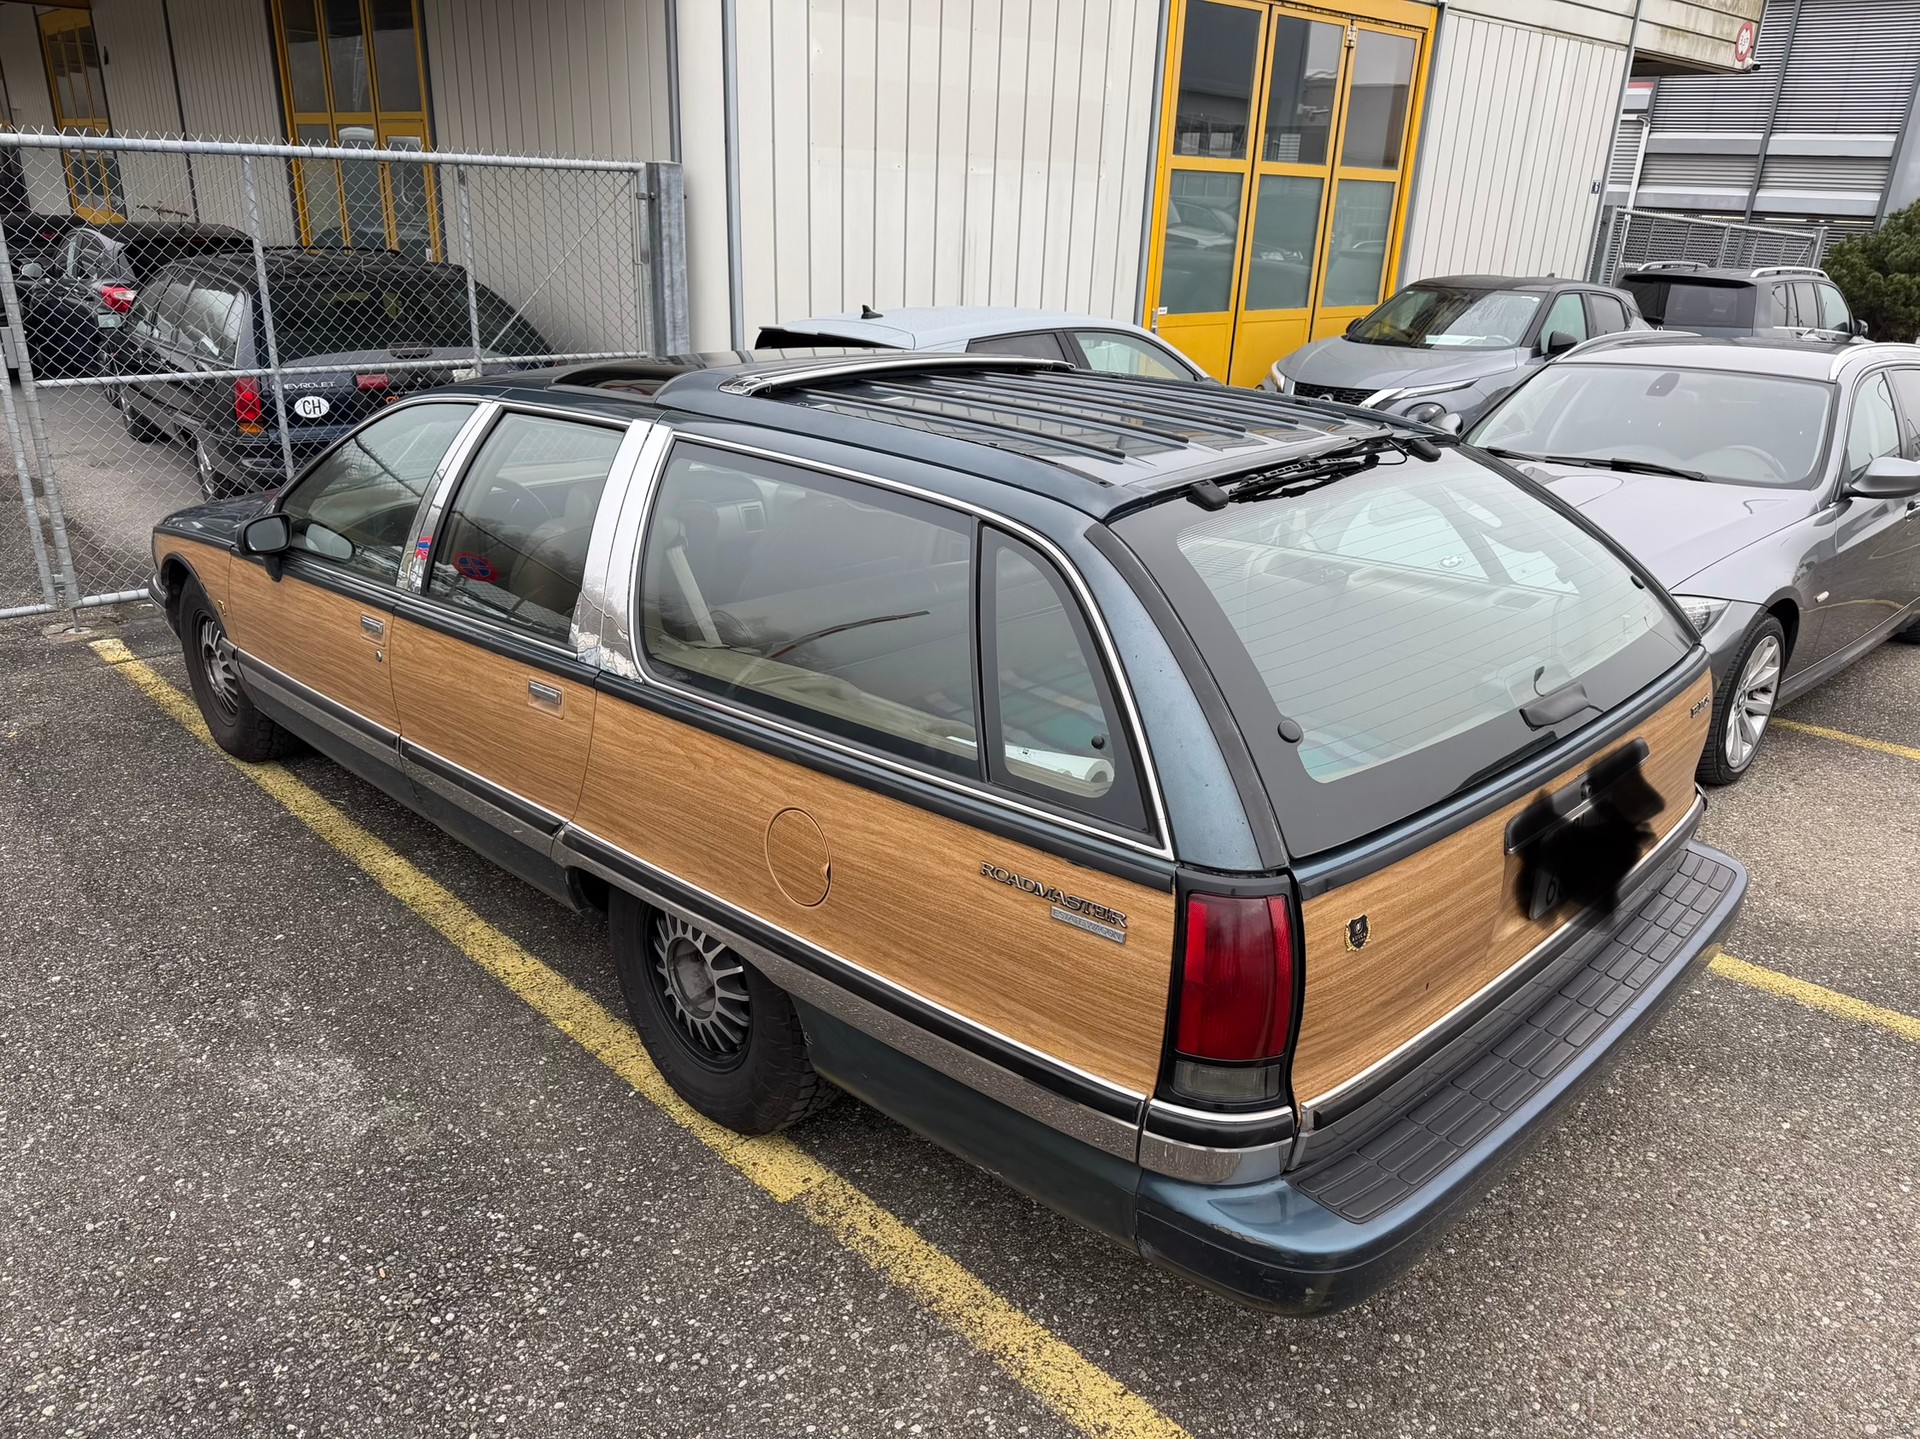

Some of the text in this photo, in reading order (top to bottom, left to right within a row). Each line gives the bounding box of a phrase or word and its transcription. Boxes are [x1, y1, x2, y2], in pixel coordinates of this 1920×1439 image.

[271, 381, 335, 390] EVROLET
[302, 399, 322, 415] CH
[980, 860, 1128, 928] ROADMASTER
[1052, 909, 1122, 941] ESTATE WAGON
